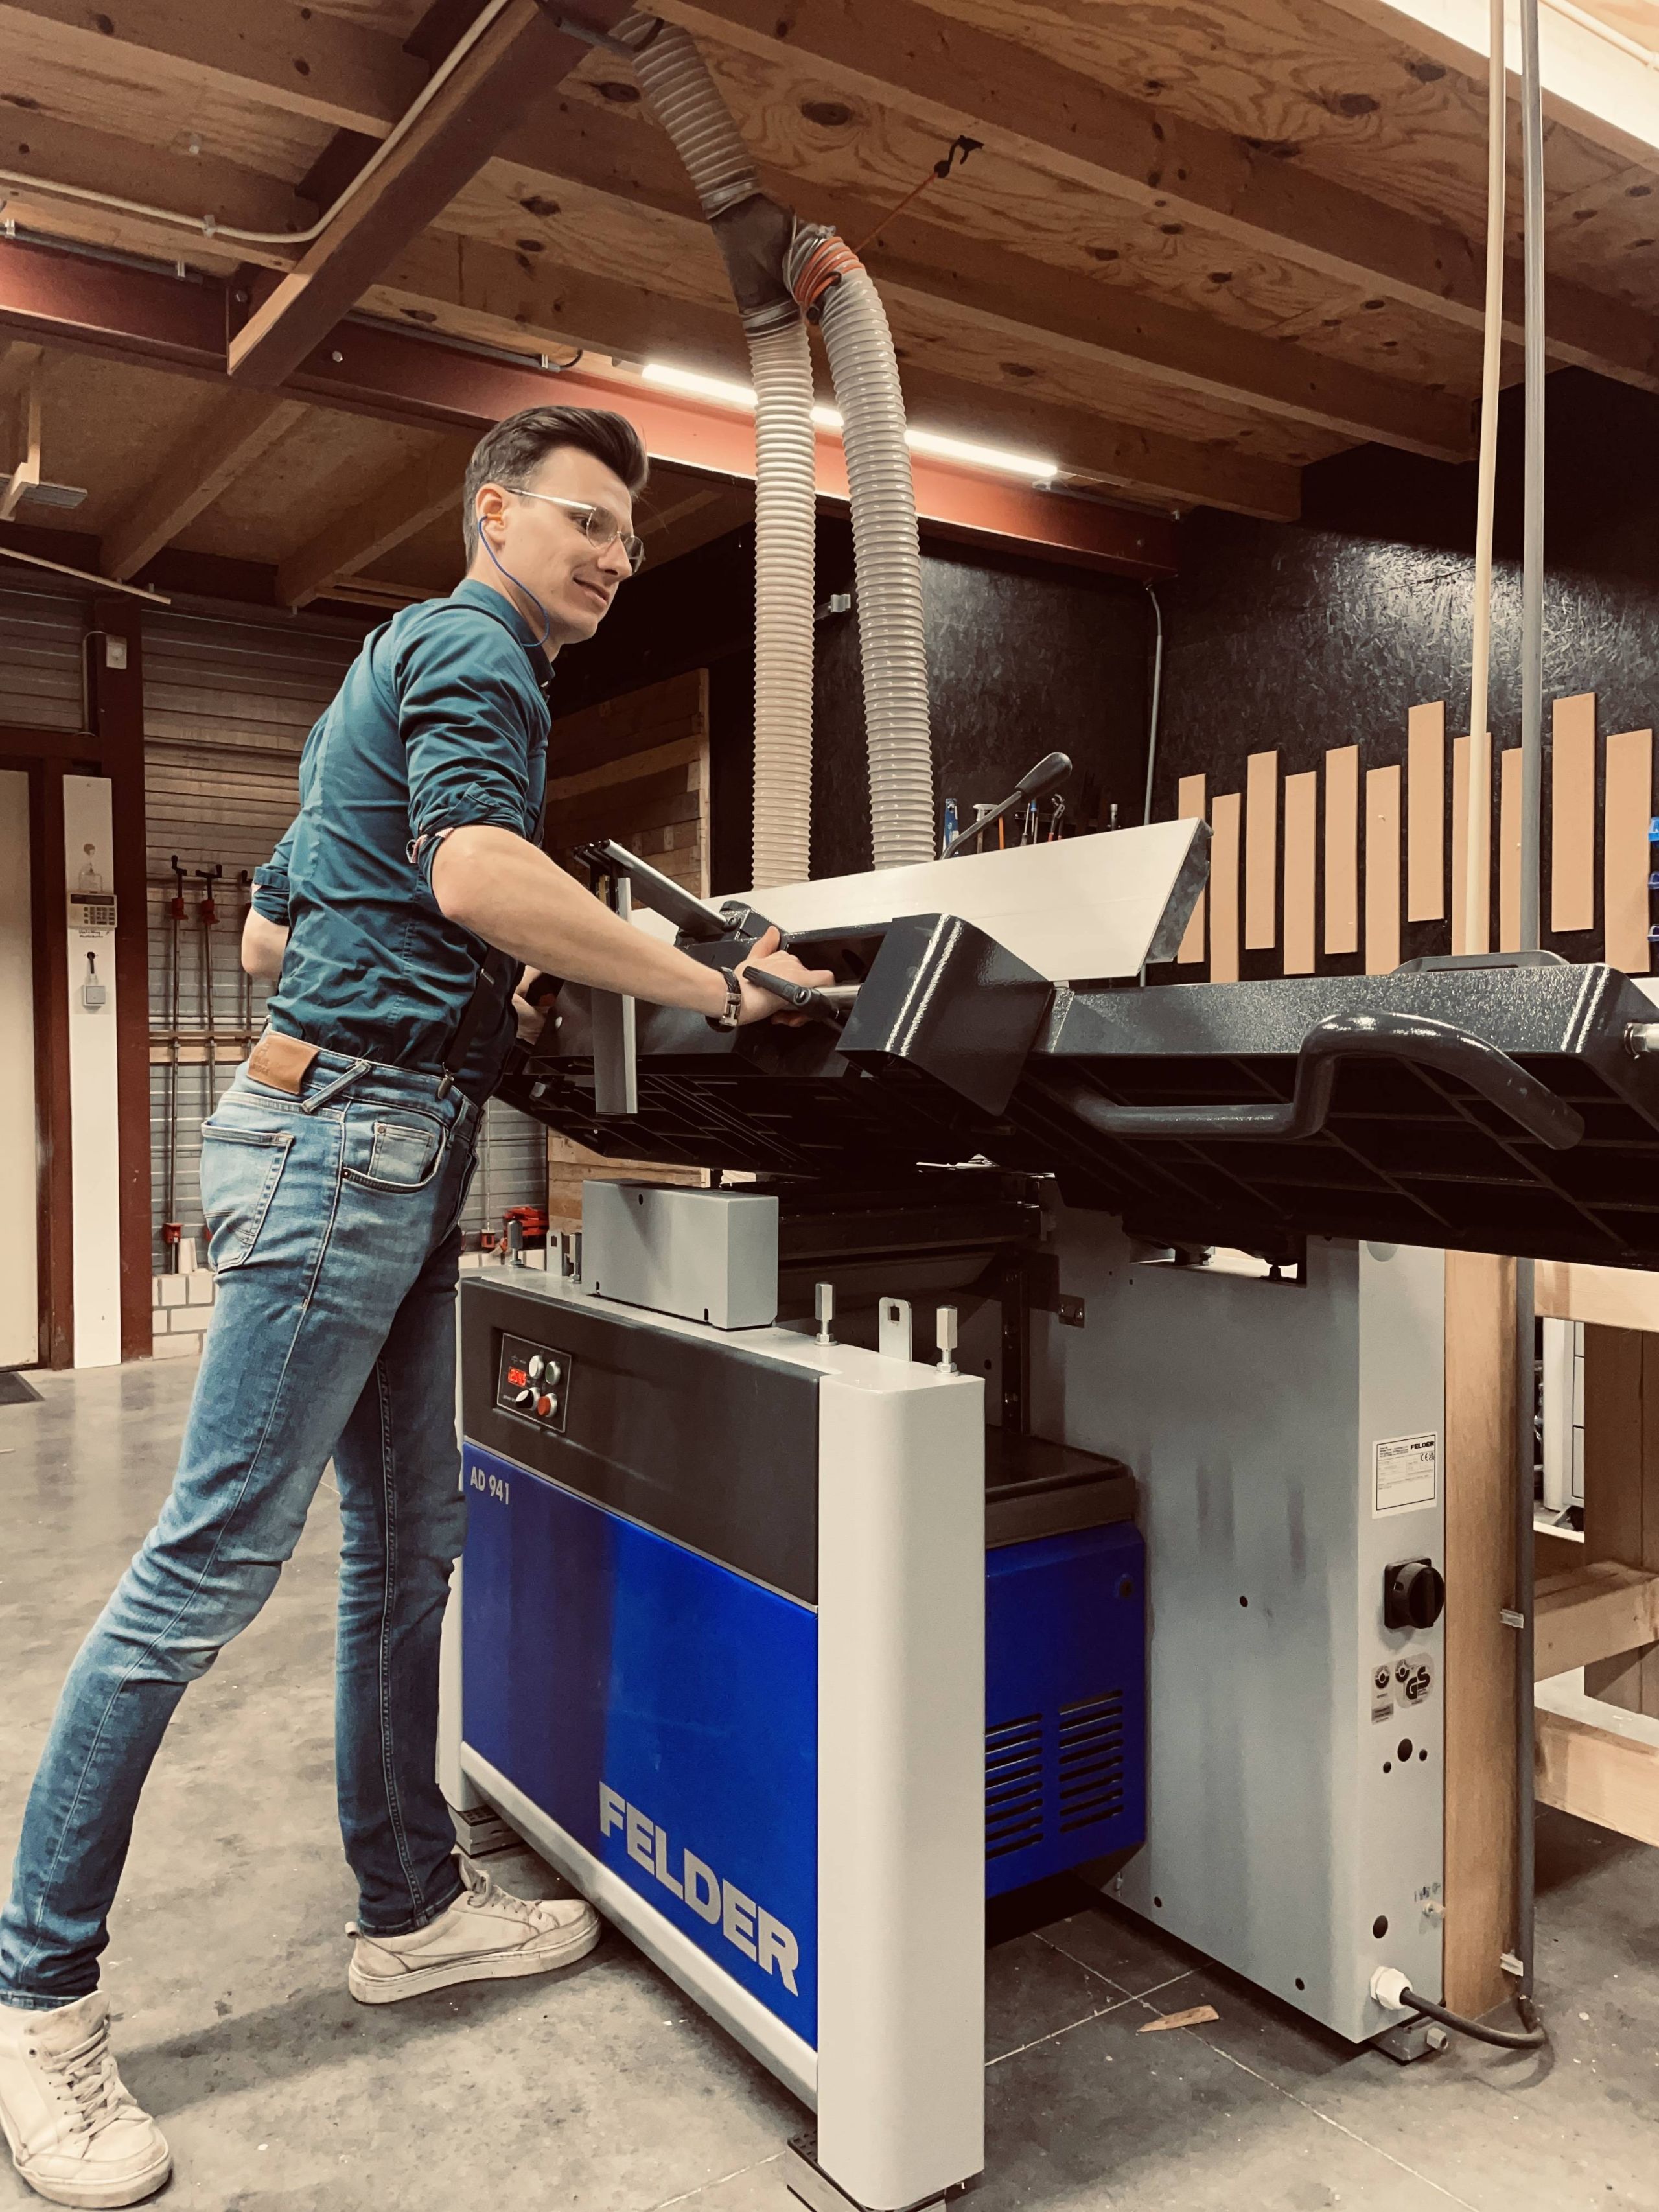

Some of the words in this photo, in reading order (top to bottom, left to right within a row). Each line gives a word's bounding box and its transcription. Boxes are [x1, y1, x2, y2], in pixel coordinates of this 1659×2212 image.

[1410, 1441, 1434, 1450] FELDER
[470, 1466, 485, 1491] AD
[489, 1474, 509, 1504] 941
[1406, 1666, 1430, 1700] GS
[599, 1781, 799, 1997] FELDER
